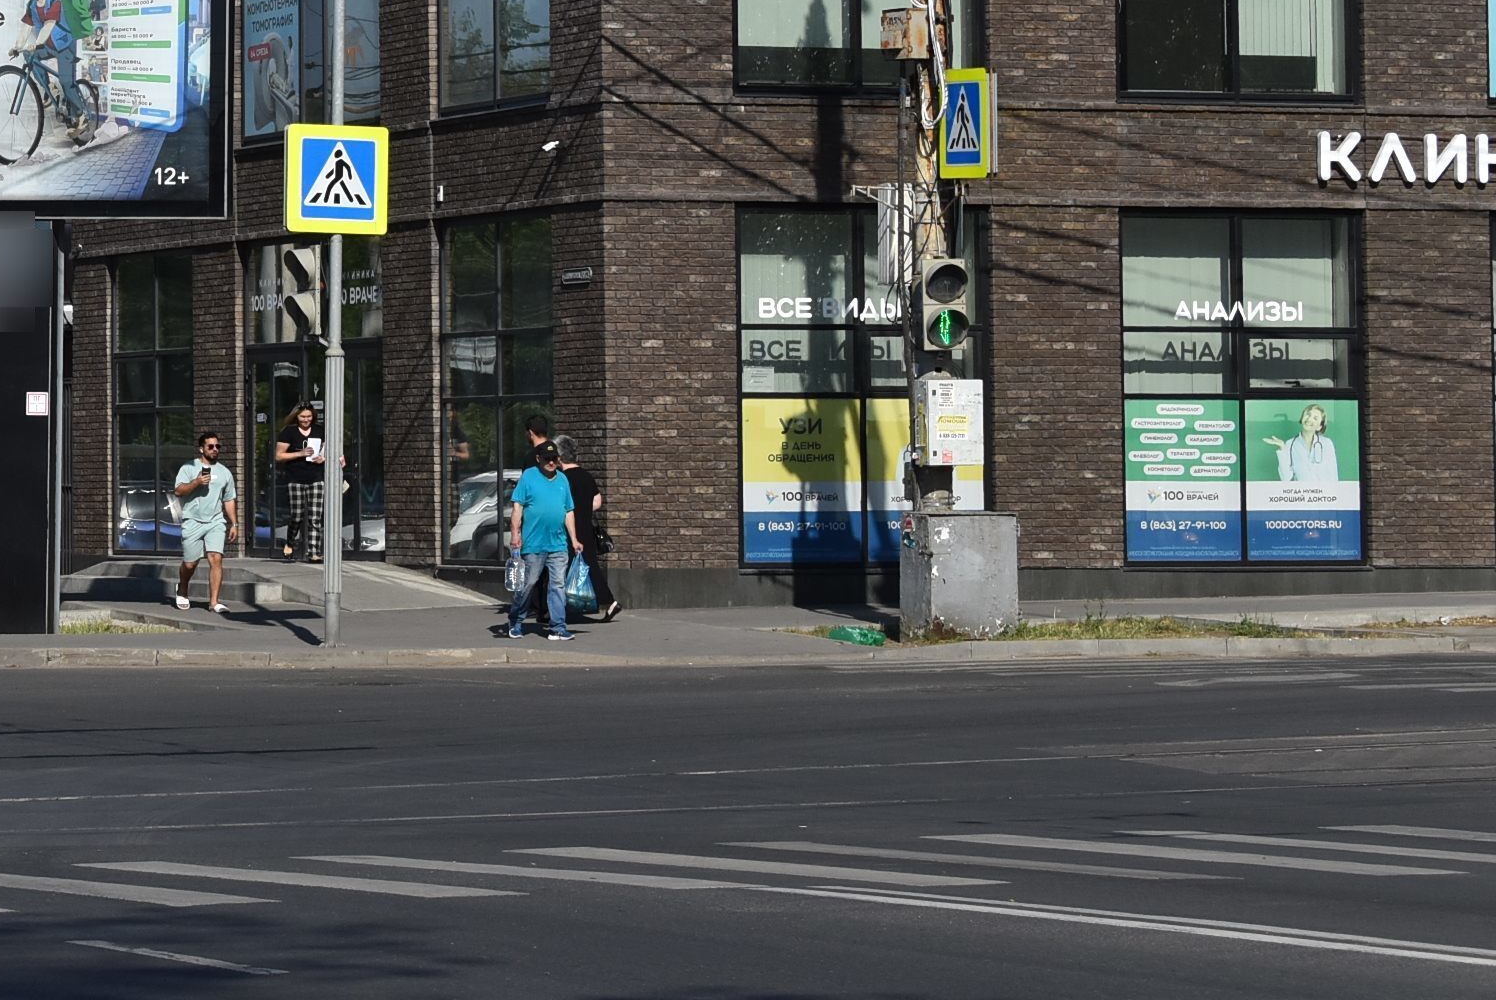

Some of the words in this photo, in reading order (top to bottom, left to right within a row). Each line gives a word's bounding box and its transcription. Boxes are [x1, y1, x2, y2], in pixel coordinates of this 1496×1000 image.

[251, 13, 294, 33] ТОМОГРАФИЯ
[154, 166, 190, 186] 12+
[758, 297, 813, 319] ВСЕ
[822, 297, 902, 322] ВИДЫ
[1173, 300, 1303, 322] АНАЛИЗЫ
[779, 417, 823, 435] УЗИ
[781, 441, 789, 450] В
[792, 441, 822, 451] ДЕНЬ
[767, 453, 835, 463] ОБРАЩЕНИЯ
[782, 491, 803, 502] 100
[805, 493, 839, 502] ВРАЧЕЙ
[1163, 490, 1184, 501] 100
[1186, 492, 1219, 501] ВРАЧЕЙ
[1268, 495, 1305, 503] ХОРОШИЙ
[758, 522, 766, 531] 8
[768, 521, 795, 532] (863)
[796, 522, 846, 531] 27-91-100
[1140, 520, 1148, 530] 8
[1150, 519, 1176, 531] (863)
[1178, 520, 1227, 530] 27-91-100
[1265, 520, 1342, 529] 100DOCTORS.RU
